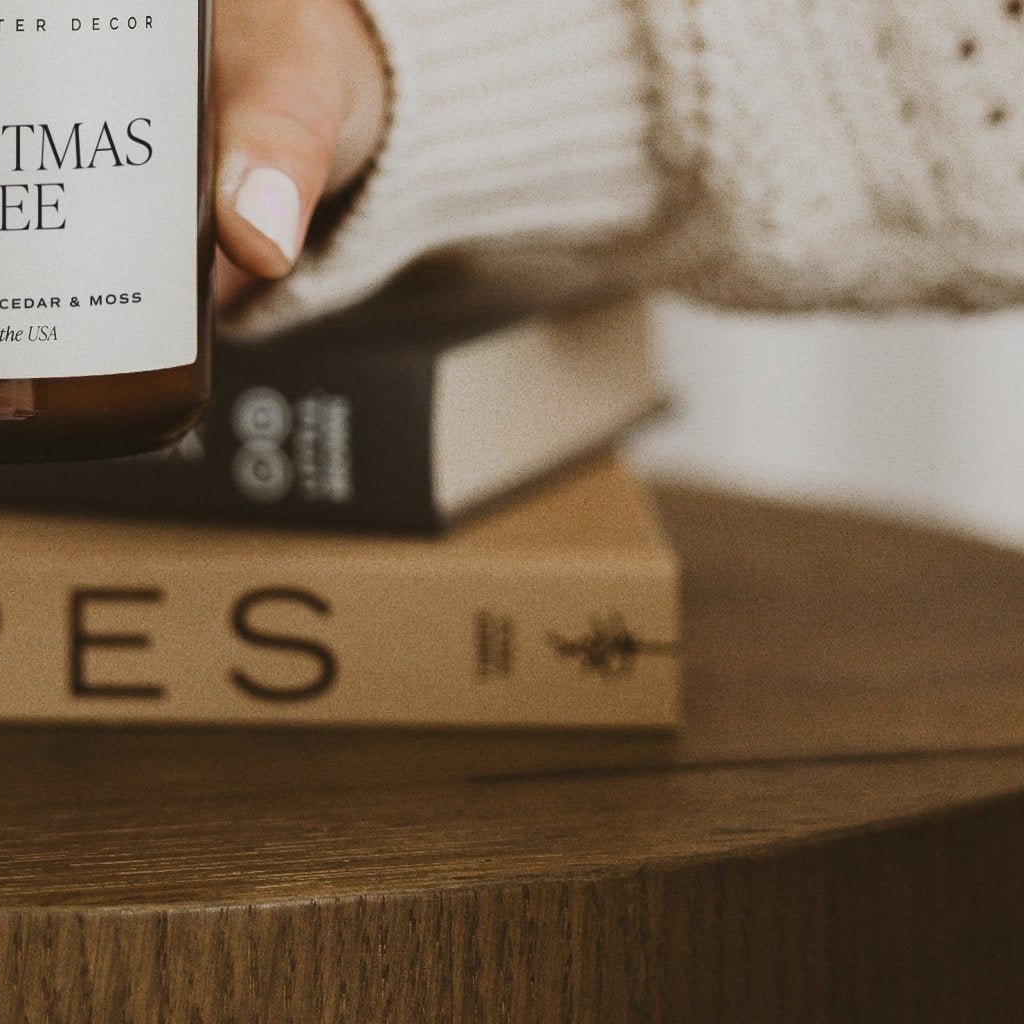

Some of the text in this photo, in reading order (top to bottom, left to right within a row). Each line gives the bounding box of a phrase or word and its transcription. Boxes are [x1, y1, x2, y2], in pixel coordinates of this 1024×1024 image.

[71, 15, 154, 32] DECOR
[68, 296, 81, 308] &
[88, 291, 143, 306] MOSS
[27, 325, 59, 342] USA
